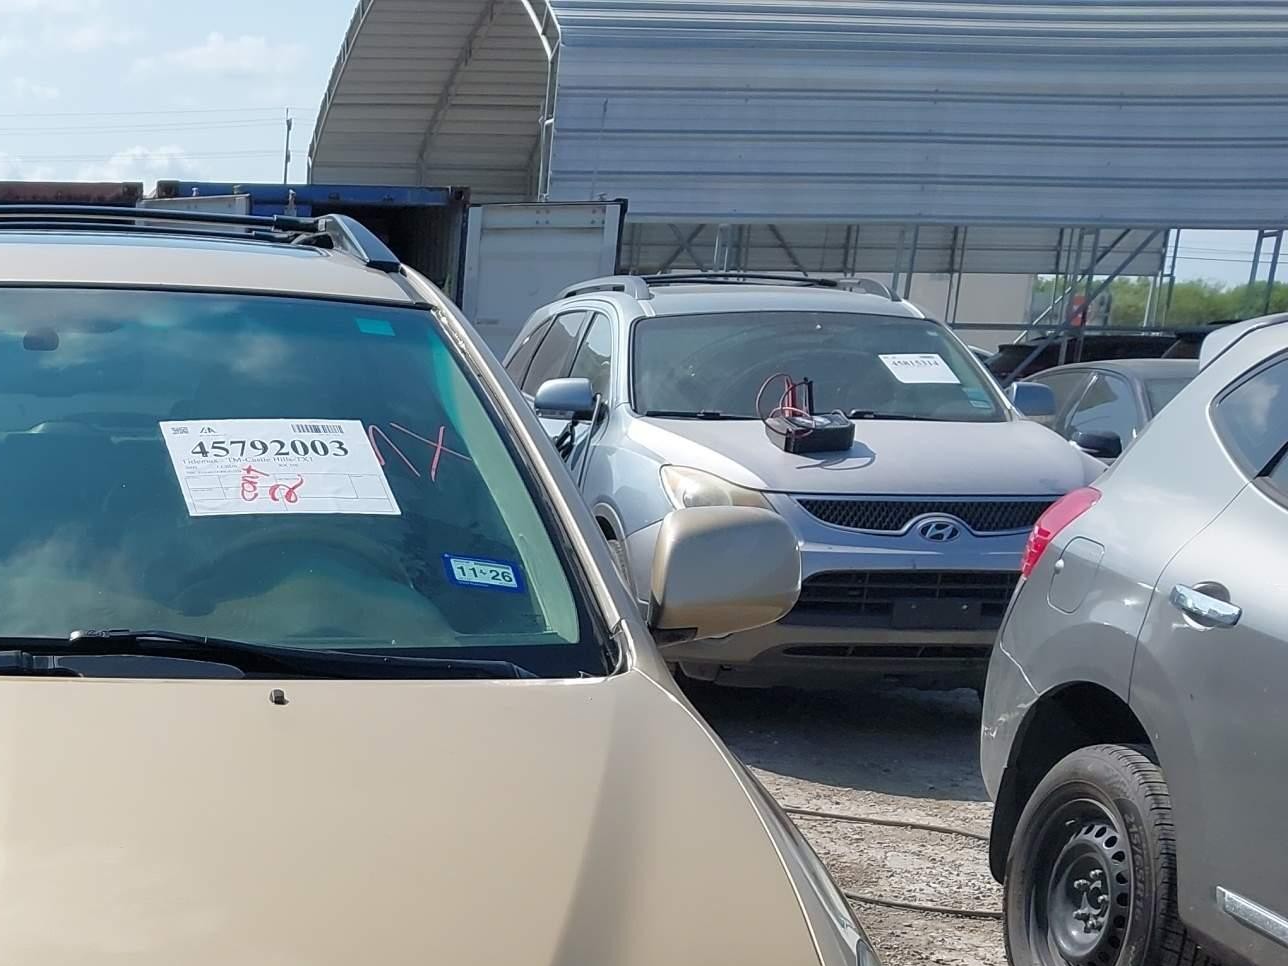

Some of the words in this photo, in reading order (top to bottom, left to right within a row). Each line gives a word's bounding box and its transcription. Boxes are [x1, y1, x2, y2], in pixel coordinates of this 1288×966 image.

[191, 439, 349, 458] 45792003
[457, 565, 479, 578] 11
[489, 569, 513, 583] 26
